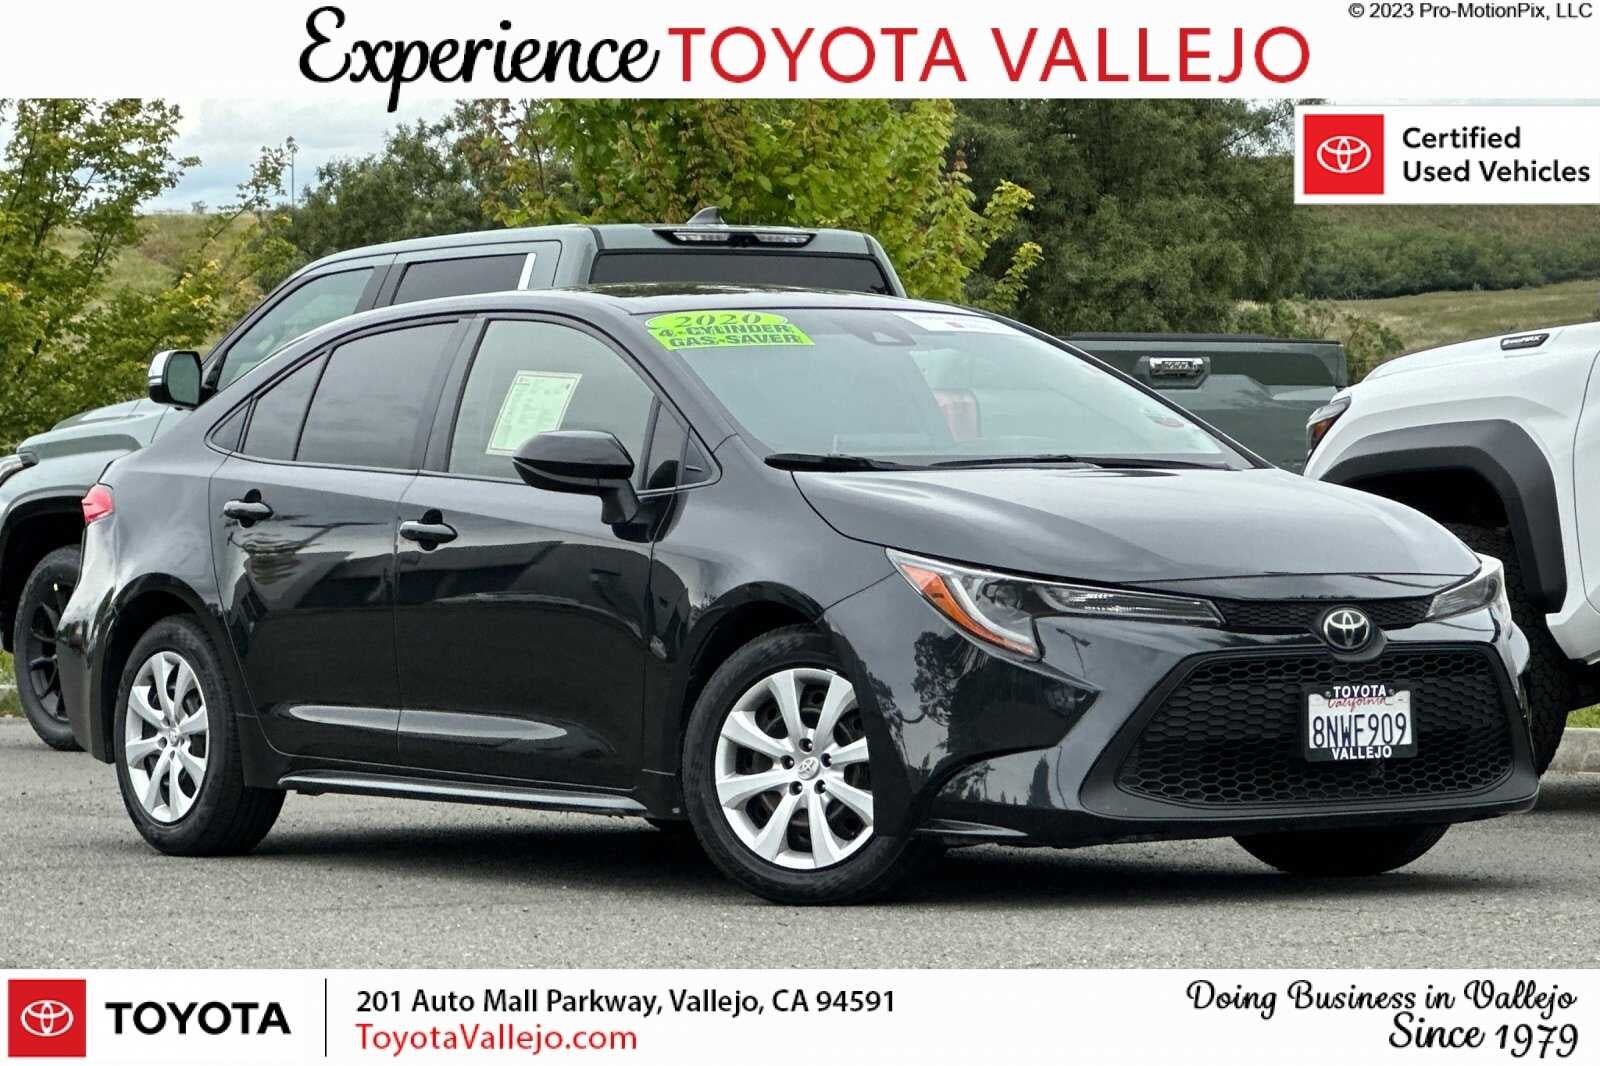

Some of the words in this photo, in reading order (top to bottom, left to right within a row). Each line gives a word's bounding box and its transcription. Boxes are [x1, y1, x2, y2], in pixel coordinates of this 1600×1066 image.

[674, 313, 762, 328] 2020
[1333, 685, 1387, 698] TOYOTA
[1313, 712, 1407, 748] 8NWF909
[1332, 746, 1392, 760] VALLEJO
